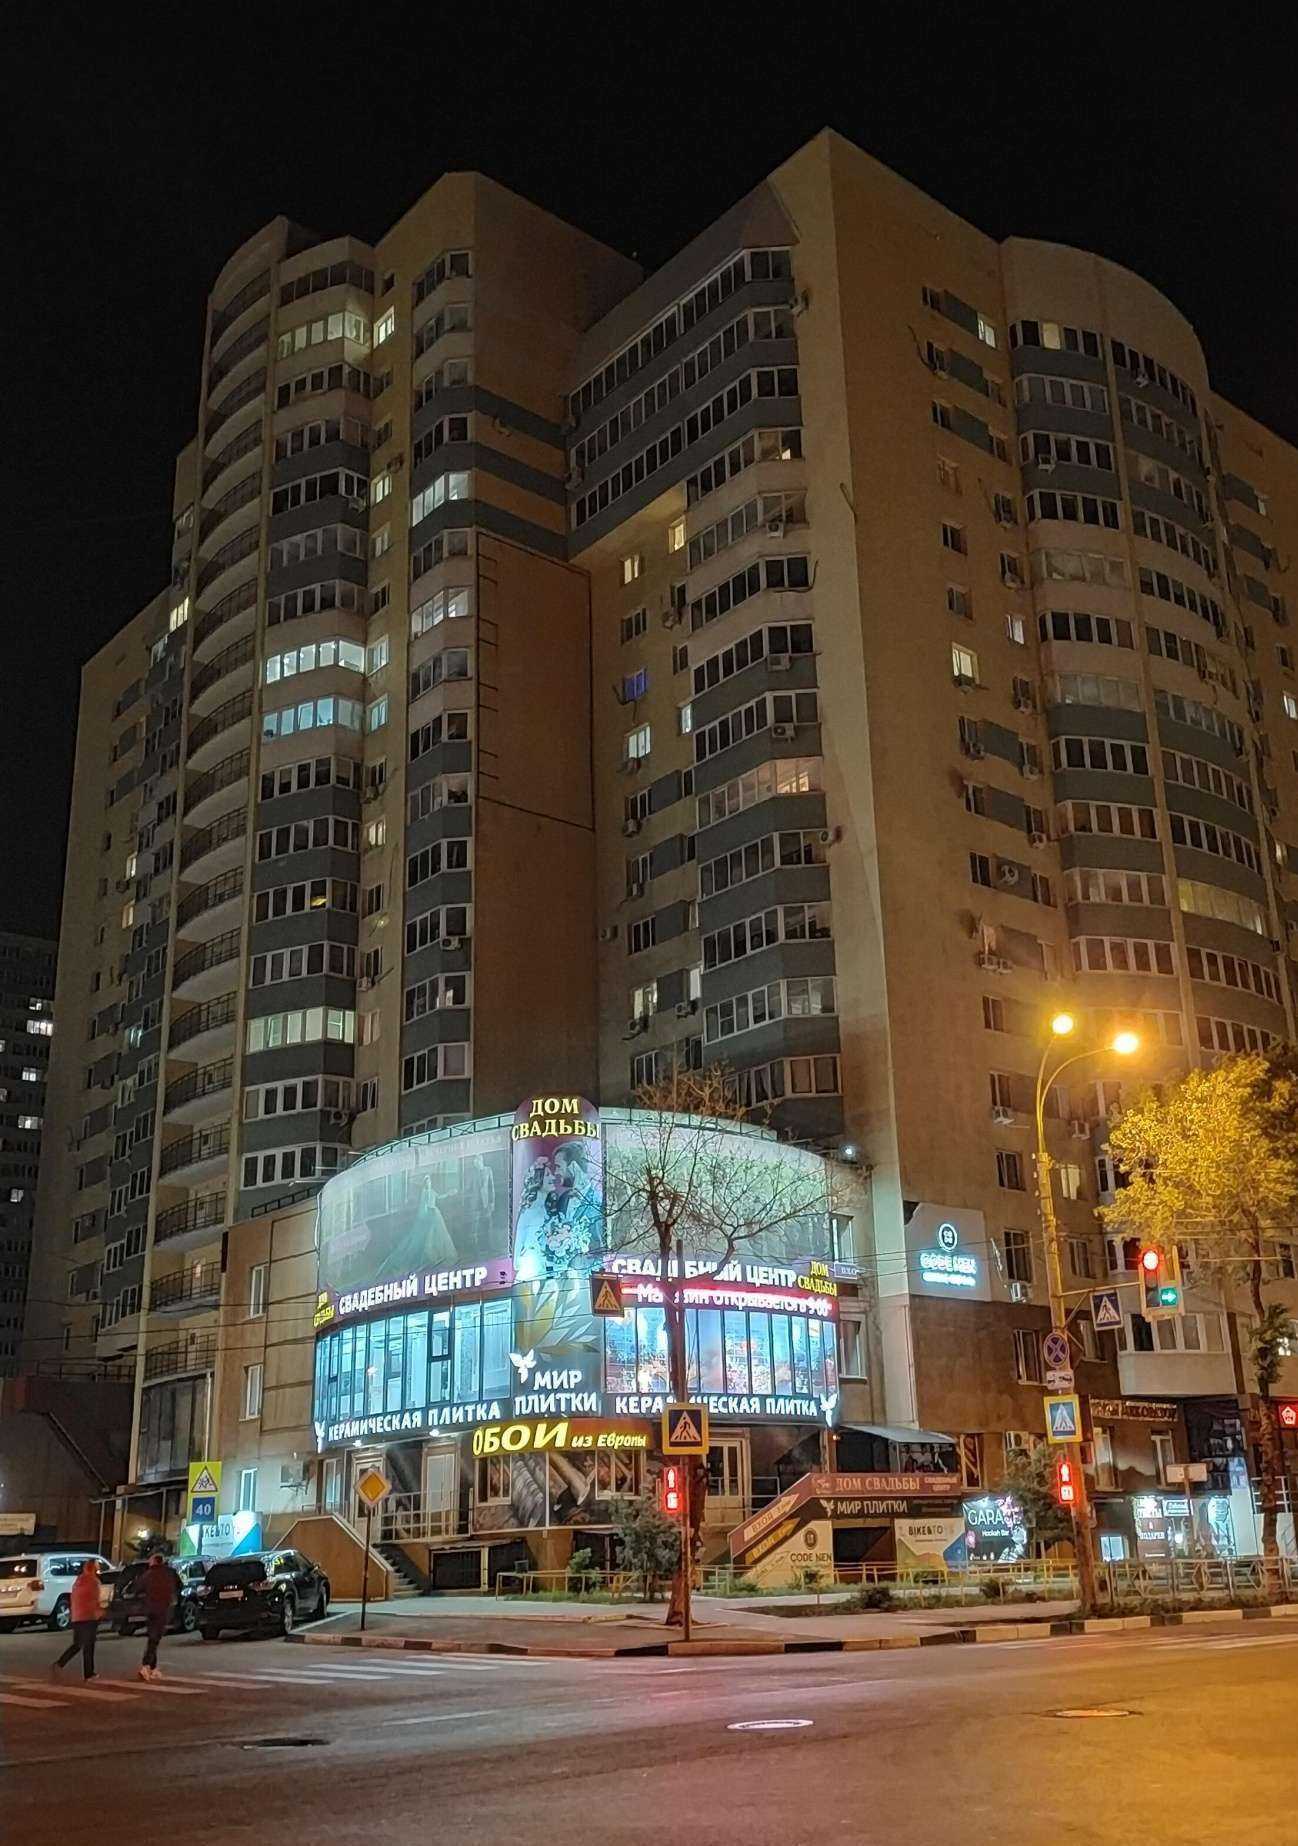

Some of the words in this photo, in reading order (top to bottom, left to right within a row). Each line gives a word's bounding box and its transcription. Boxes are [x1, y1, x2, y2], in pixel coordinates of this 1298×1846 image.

[530, 1098, 579, 1118] ДОМ
[511, 1119, 600, 1141] СВАДЬБЫ
[746, 1264, 797, 1288] ЦЕНТР
[810, 1261, 829, 1277] ДОМ
[338, 1273, 418, 1315] СВАДЕБНЫЙ
[424, 1266, 488, 1297] ЦЕНТР
[797, 1275, 837, 1297] СВАДЬБЫ
[533, 1369, 582, 1390] МИР
[515, 1392, 597, 1416] ПЛИТКИ
[615, 1396, 760, 1414] КЕРАЕСКАЯ
[766, 1398, 818, 1416] ПЛИТКА
[328, 1410, 422, 1442] КЕРАМИЧЕСКАЯ
[428, 1401, 501, 1426] ПЛИТКА
[472, 1421, 569, 1456] ОБОИ
[571, 1435, 593, 1448] из
[597, 1431, 648, 1449] Европы
[835, 1477, 861, 1491] ДОМ
[865, 1477, 920, 1490] СВАДЬБЫ
[196, 1503, 212, 1516] 40
[837, 1501, 862, 1515] МИР
[864, 1500, 908, 1515] ПЛИТКИ
[790, 1552, 813, 1561] CODE
